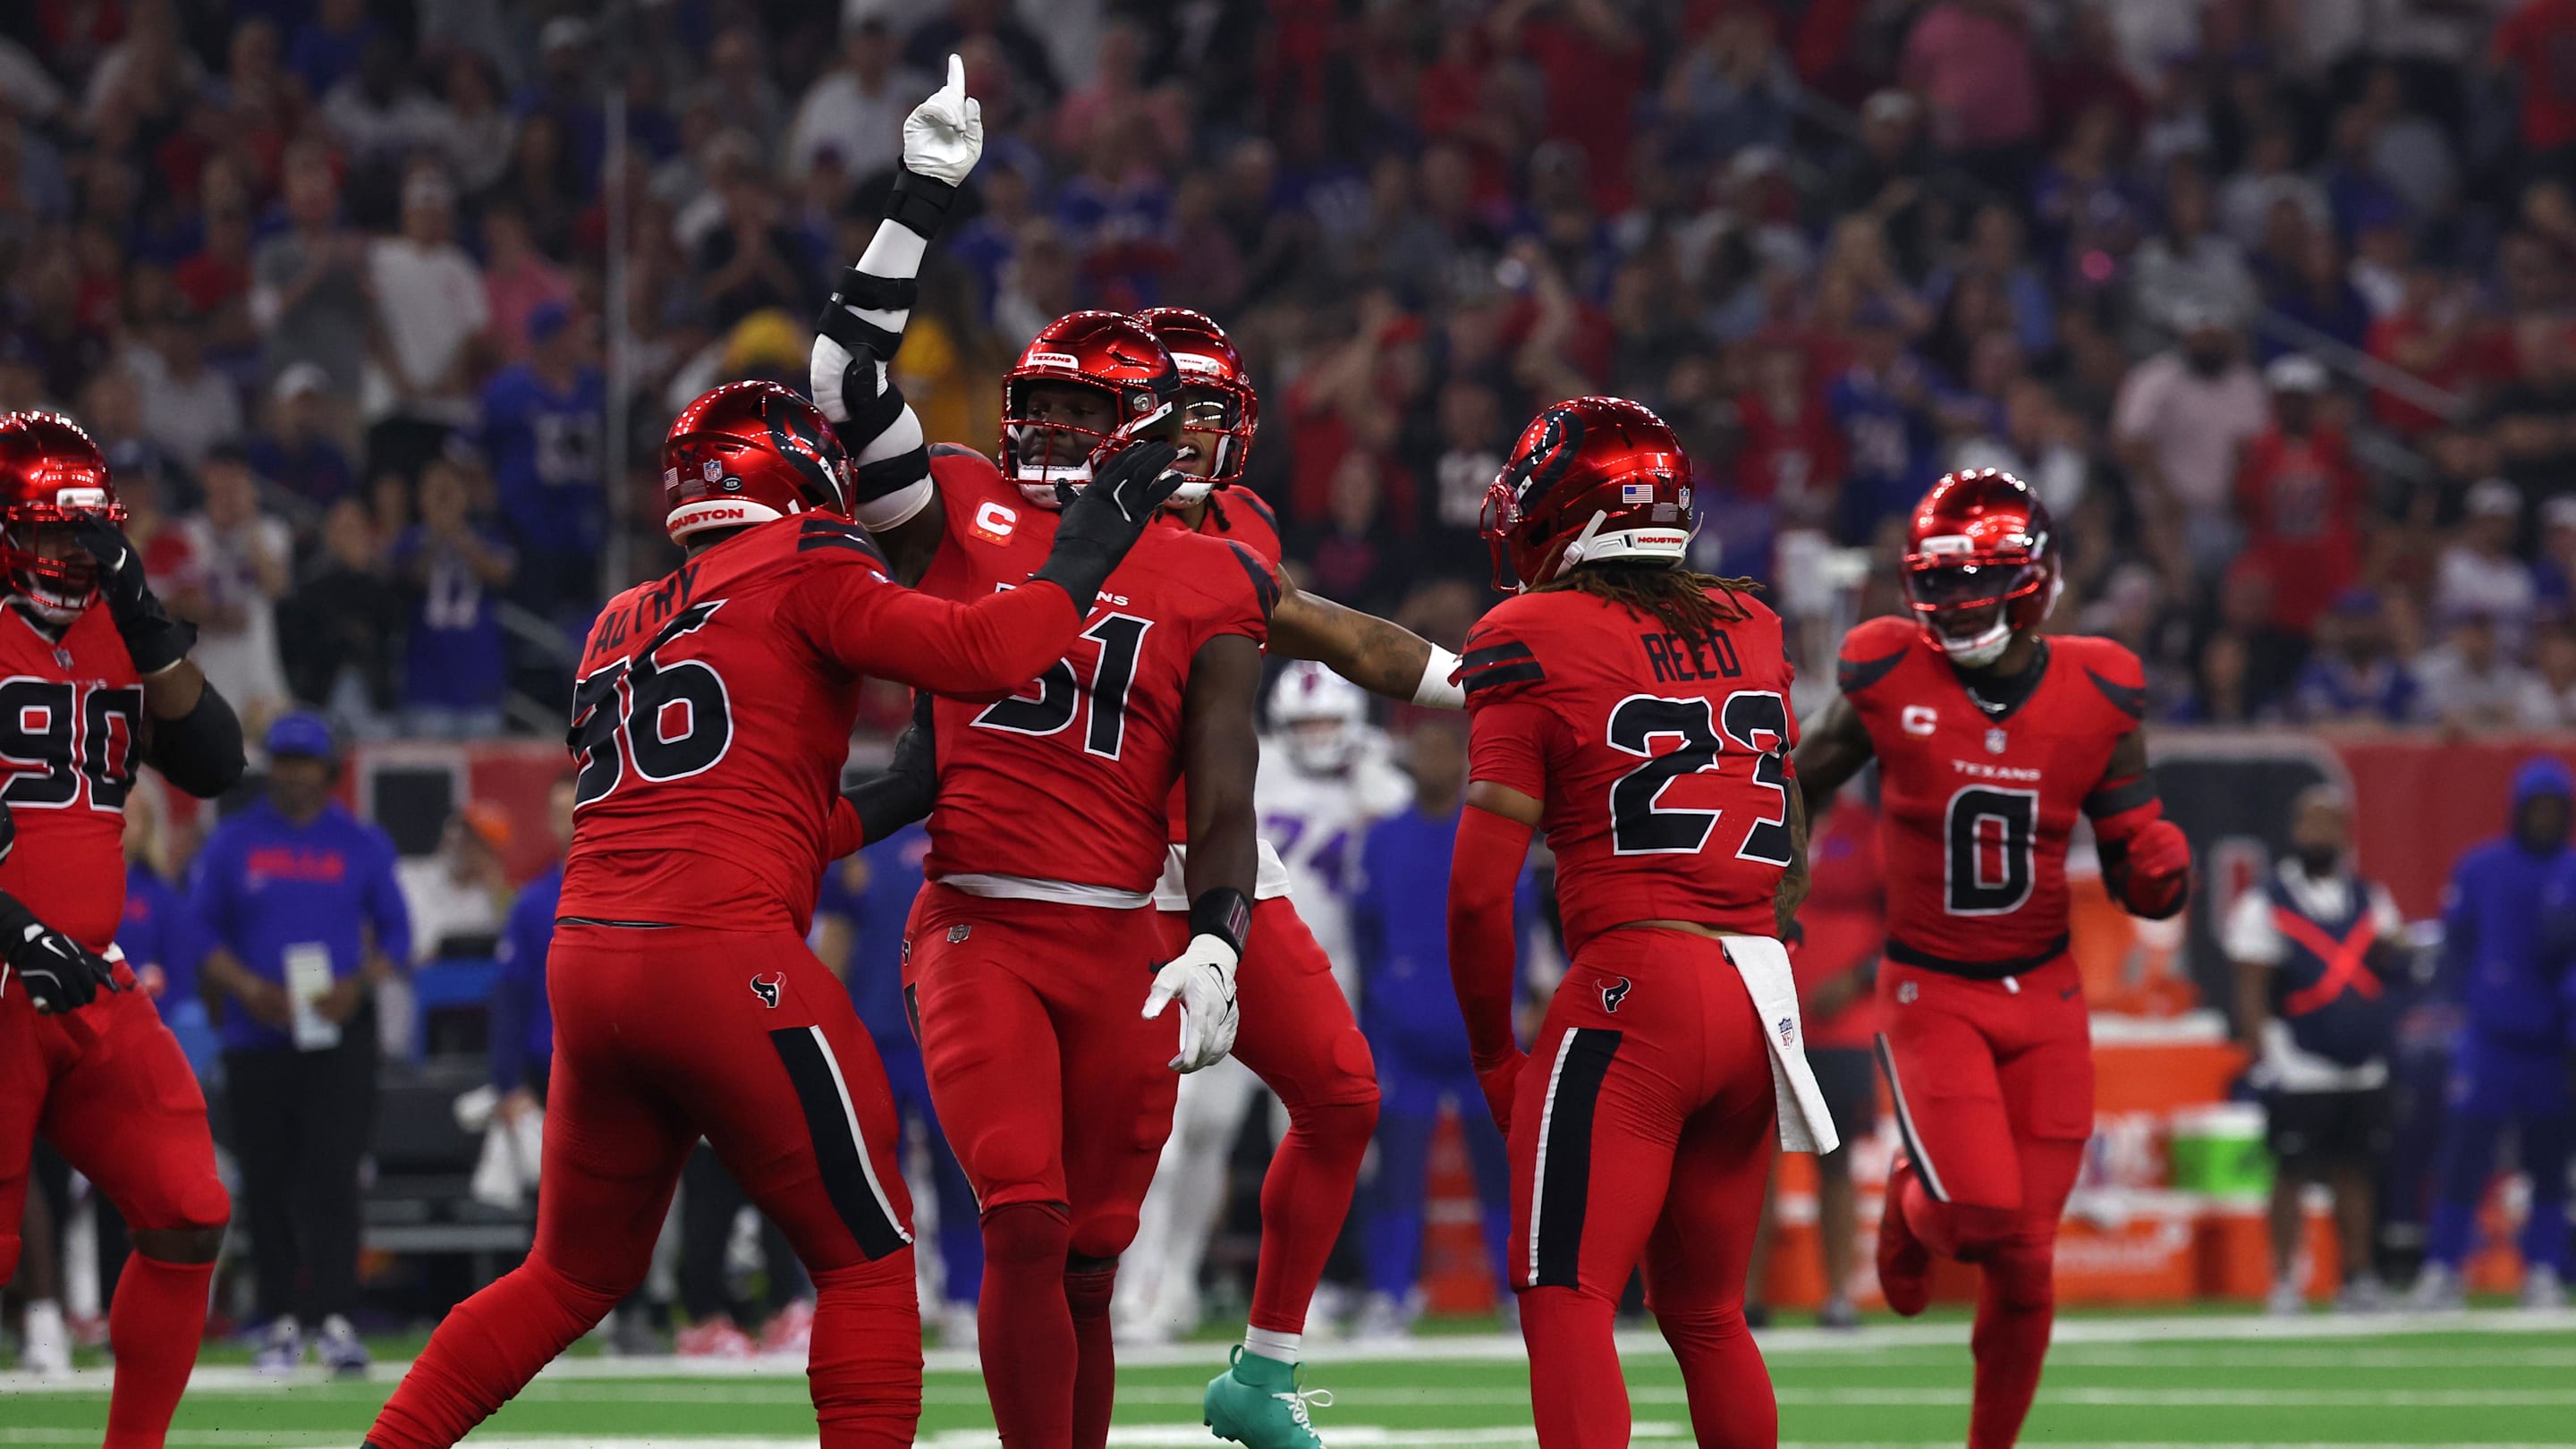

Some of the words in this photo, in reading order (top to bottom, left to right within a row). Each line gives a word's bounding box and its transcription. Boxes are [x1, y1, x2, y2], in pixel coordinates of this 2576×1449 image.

[1032, 355, 1072, 363] TEXANS
[975, 502, 1017, 537] C
[1902, 704, 1938, 736] C
[0, 675, 145, 814] 90
[1606, 690, 1792, 869] 23
[1952, 759, 2041, 782] TEXANS
[1944, 784, 2040, 918] 0
